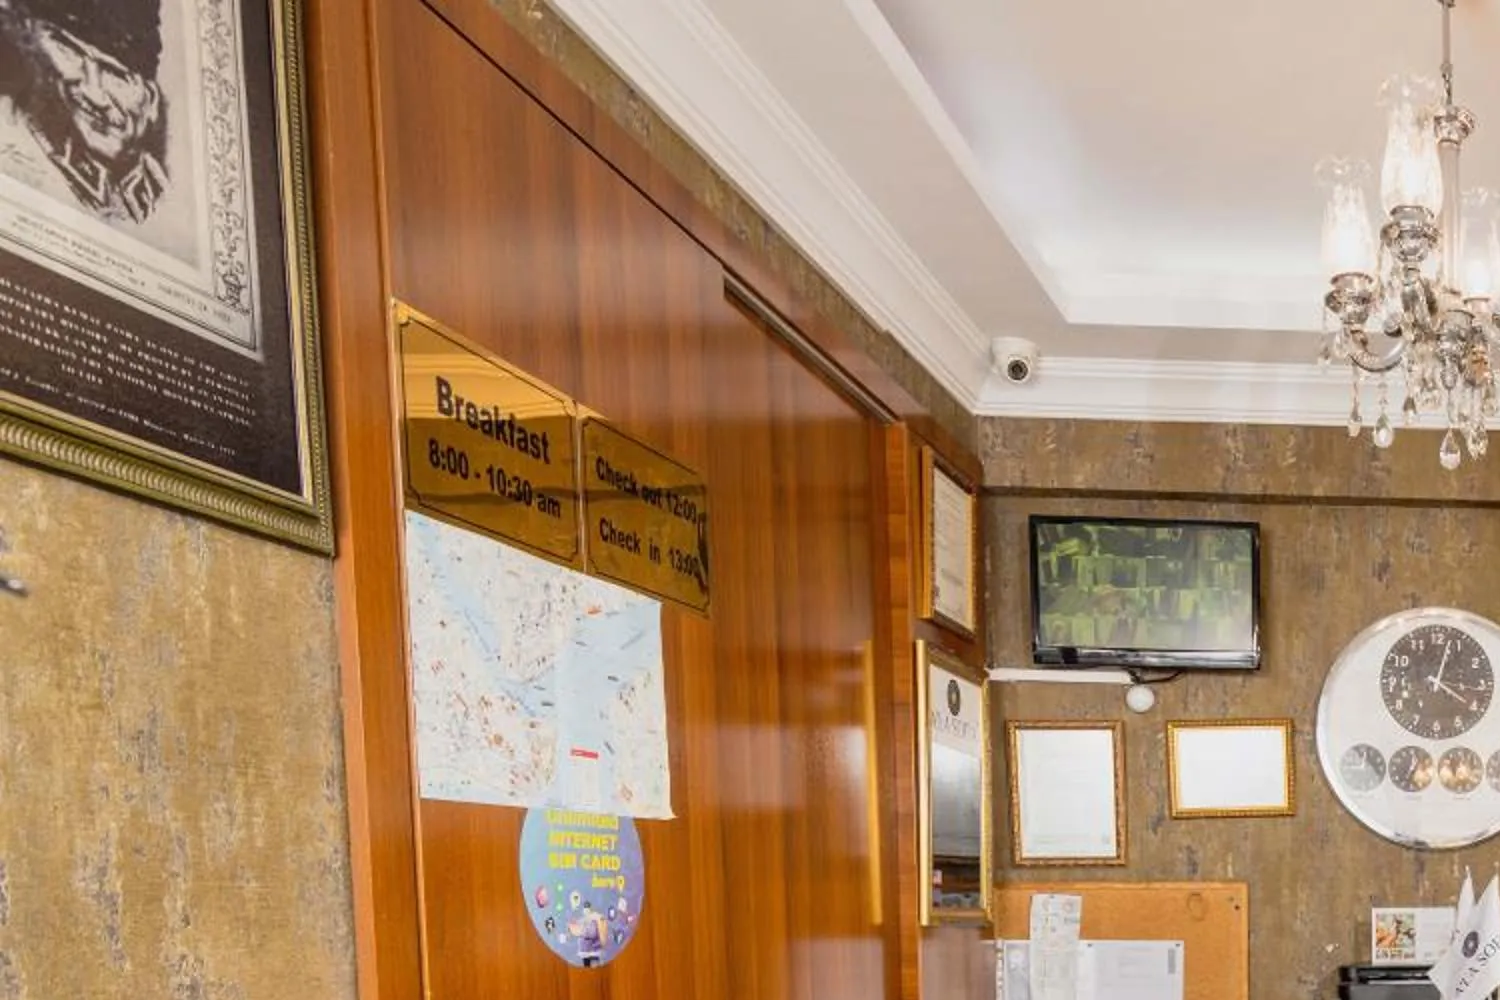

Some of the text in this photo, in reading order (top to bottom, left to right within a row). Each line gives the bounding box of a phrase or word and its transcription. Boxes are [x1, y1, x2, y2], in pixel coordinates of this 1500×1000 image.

[436, 375, 551, 464] Breakfast
[428, 437, 469, 480] 8:00
[486, 463, 533, 506] 10:30
[537, 492, 561, 519] am
[596, 455, 697, 524] Check out 12:00
[600, 517, 641, 555] Check
[649, 537, 661, 565] in
